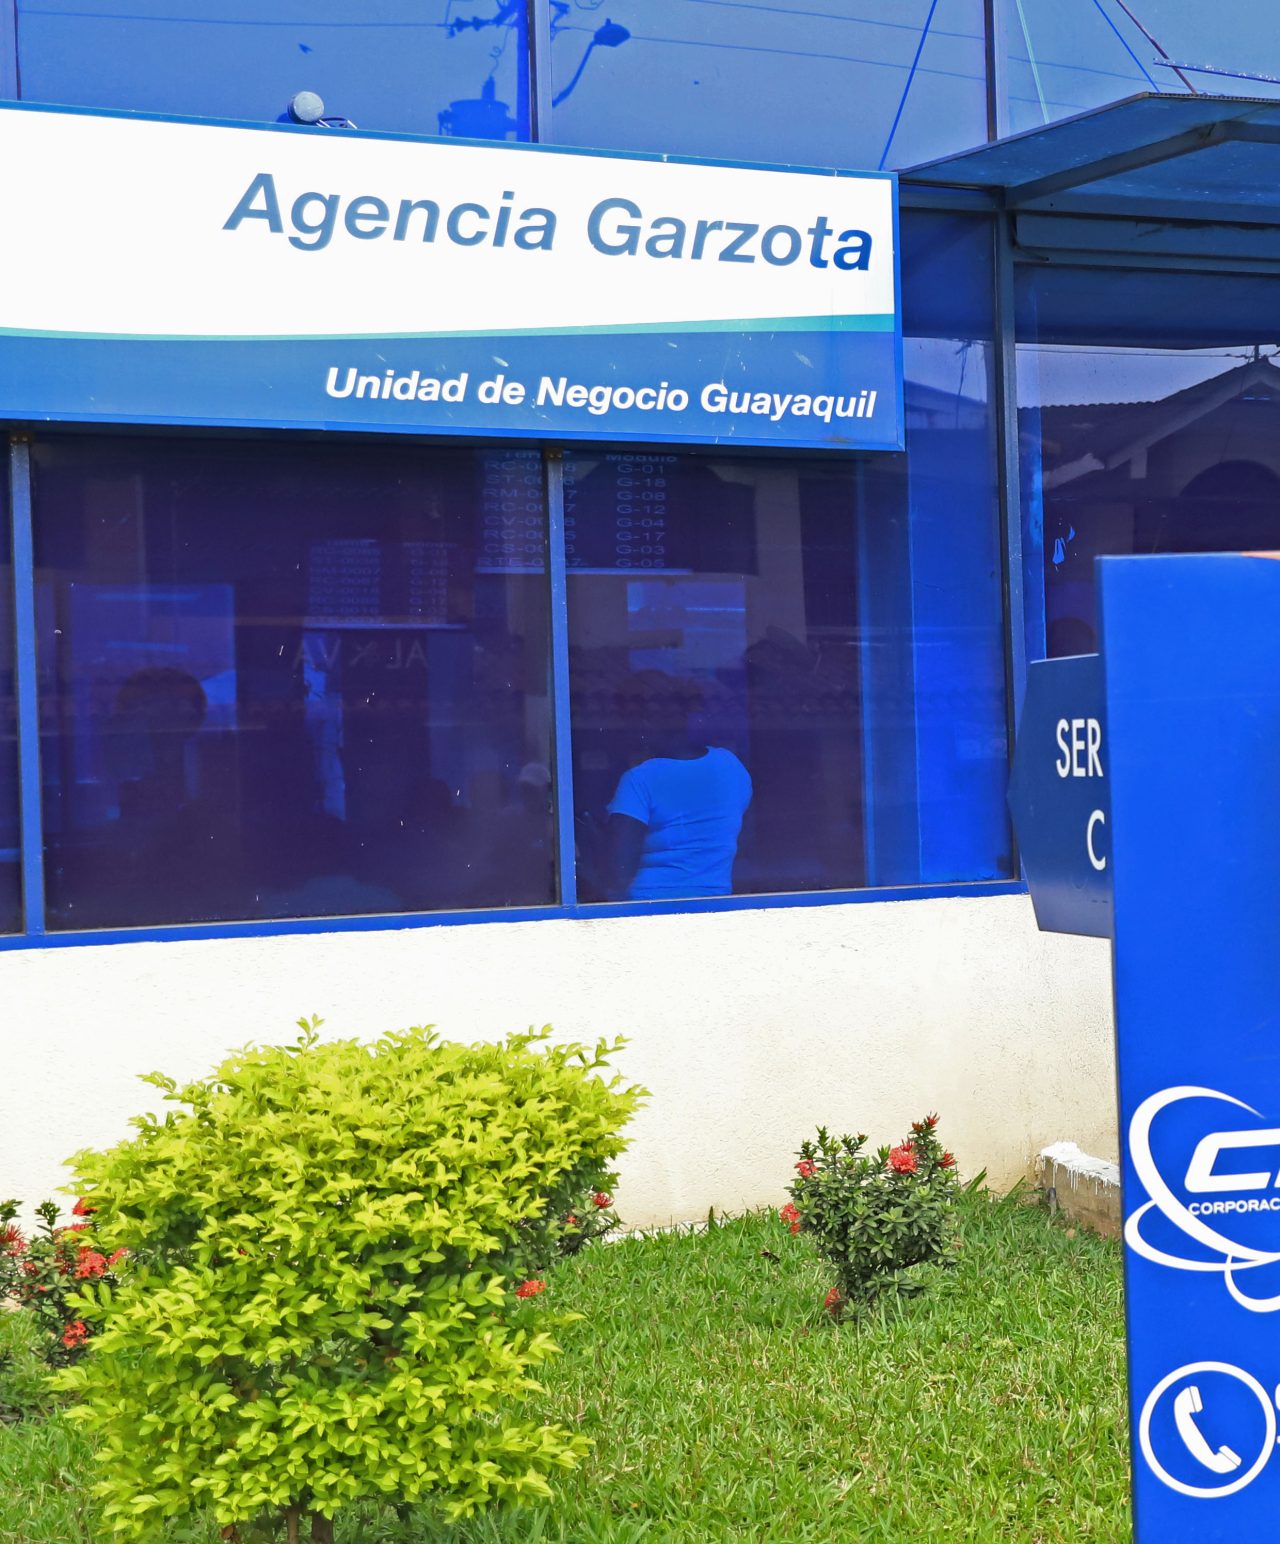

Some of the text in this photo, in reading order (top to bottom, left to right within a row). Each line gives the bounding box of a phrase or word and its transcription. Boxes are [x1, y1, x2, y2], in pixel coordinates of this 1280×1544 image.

[222, 172, 873, 271] Agencia Garzota
[325, 366, 877, 423] Unidad de Negocio Guayaquil
[617, 464, 664, 476] G-01
[616, 476, 666, 488] G-18
[616, 490, 666, 502] G-08
[616, 503, 666, 516] G-12
[616, 530, 666, 542] G-17
[616, 544, 665, 556] G-03
